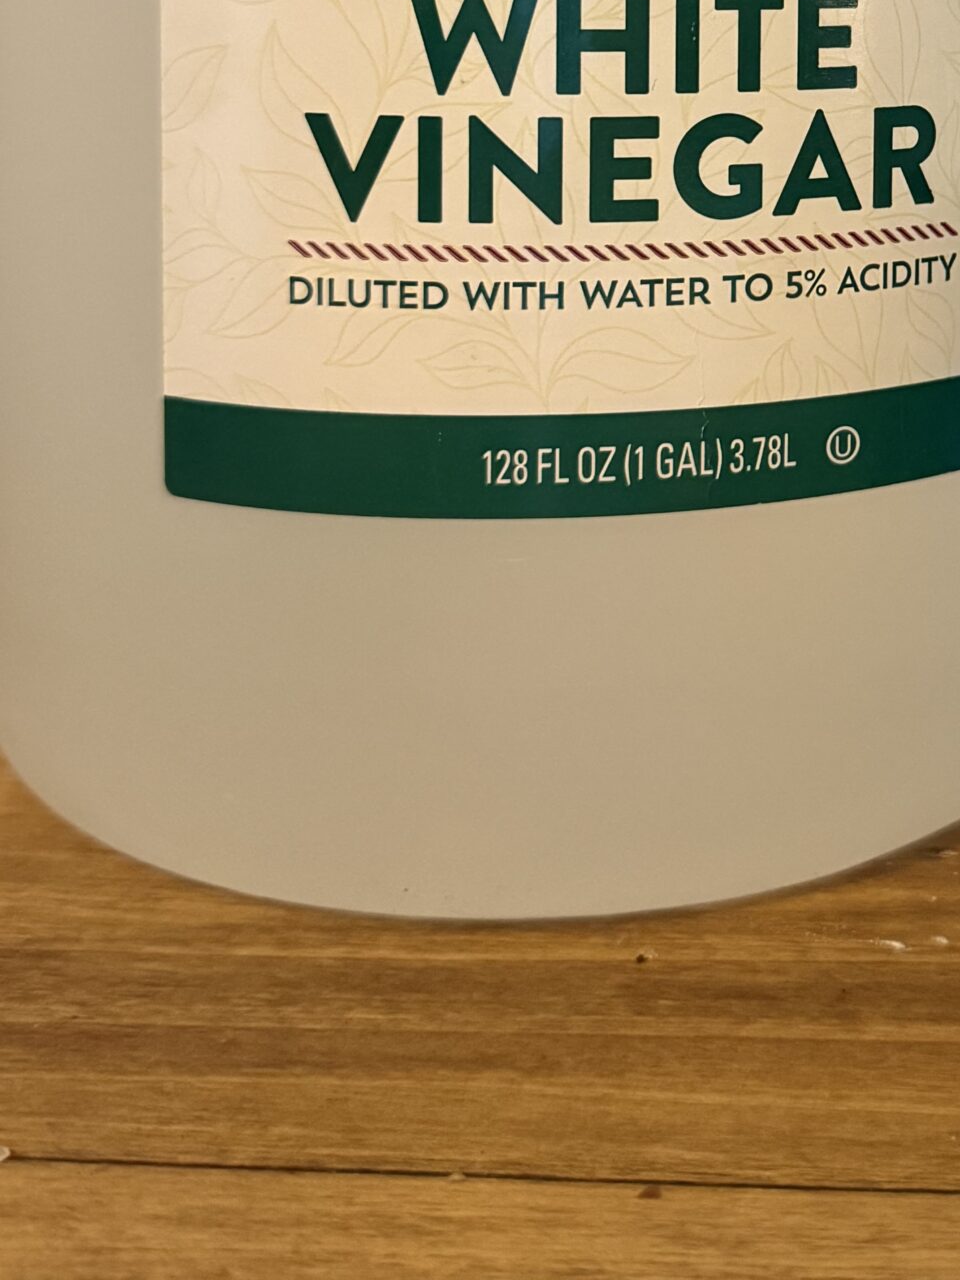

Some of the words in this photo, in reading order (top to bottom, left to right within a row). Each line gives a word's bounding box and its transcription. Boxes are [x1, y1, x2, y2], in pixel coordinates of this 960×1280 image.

[304, 104, 937, 226] VINEGAR
[288, 275, 450, 311] DILUTED
[462, 279, 565, 311] WITH
[580, 276, 711, 310] WATER
[722, 272, 774, 304] TO
[784, 267, 828, 300] 5%
[837, 252, 958, 296] ACIDITY
[481, 449, 529, 485] 128
[536, 447, 569, 484] FL
[577, 445, 616, 483] OZ
[623, 443, 644, 487] (1
[656, 437, 723, 480] GAL)
[729, 432, 797, 474] 3.78L
